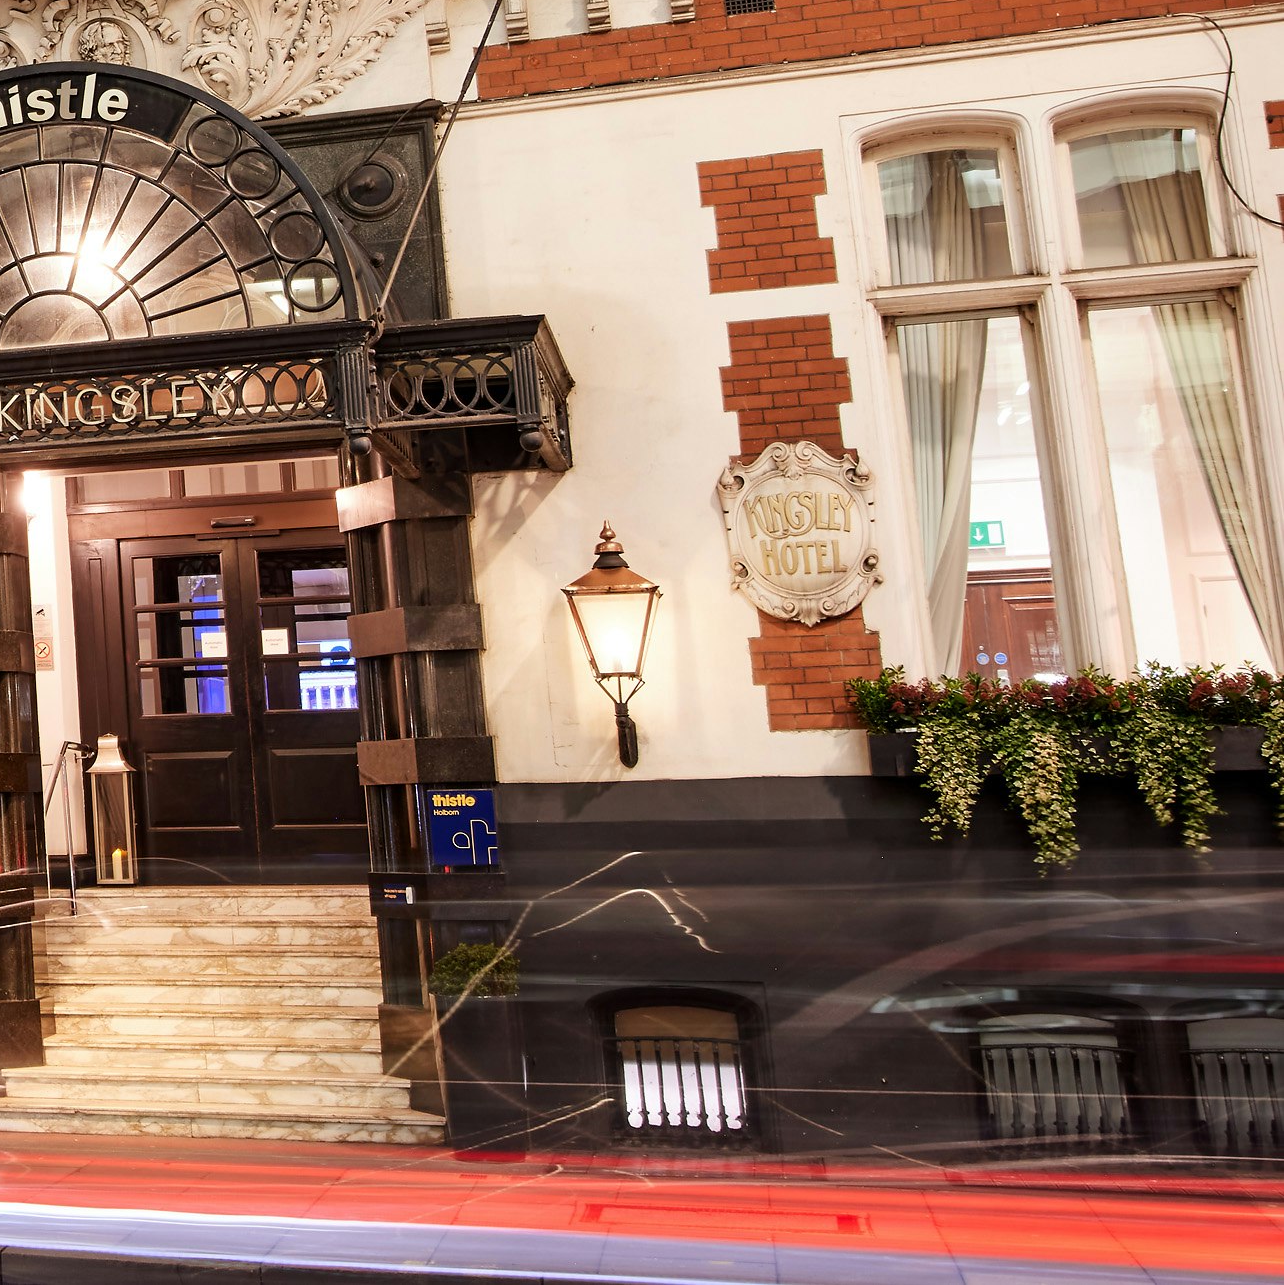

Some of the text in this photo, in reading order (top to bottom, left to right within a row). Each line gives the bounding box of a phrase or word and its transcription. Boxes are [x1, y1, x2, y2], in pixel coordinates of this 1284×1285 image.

[743, 491, 855, 539] KINGSLEY
[760, 539, 848, 575] HOTEL
[432, 794, 476, 807] thistle
